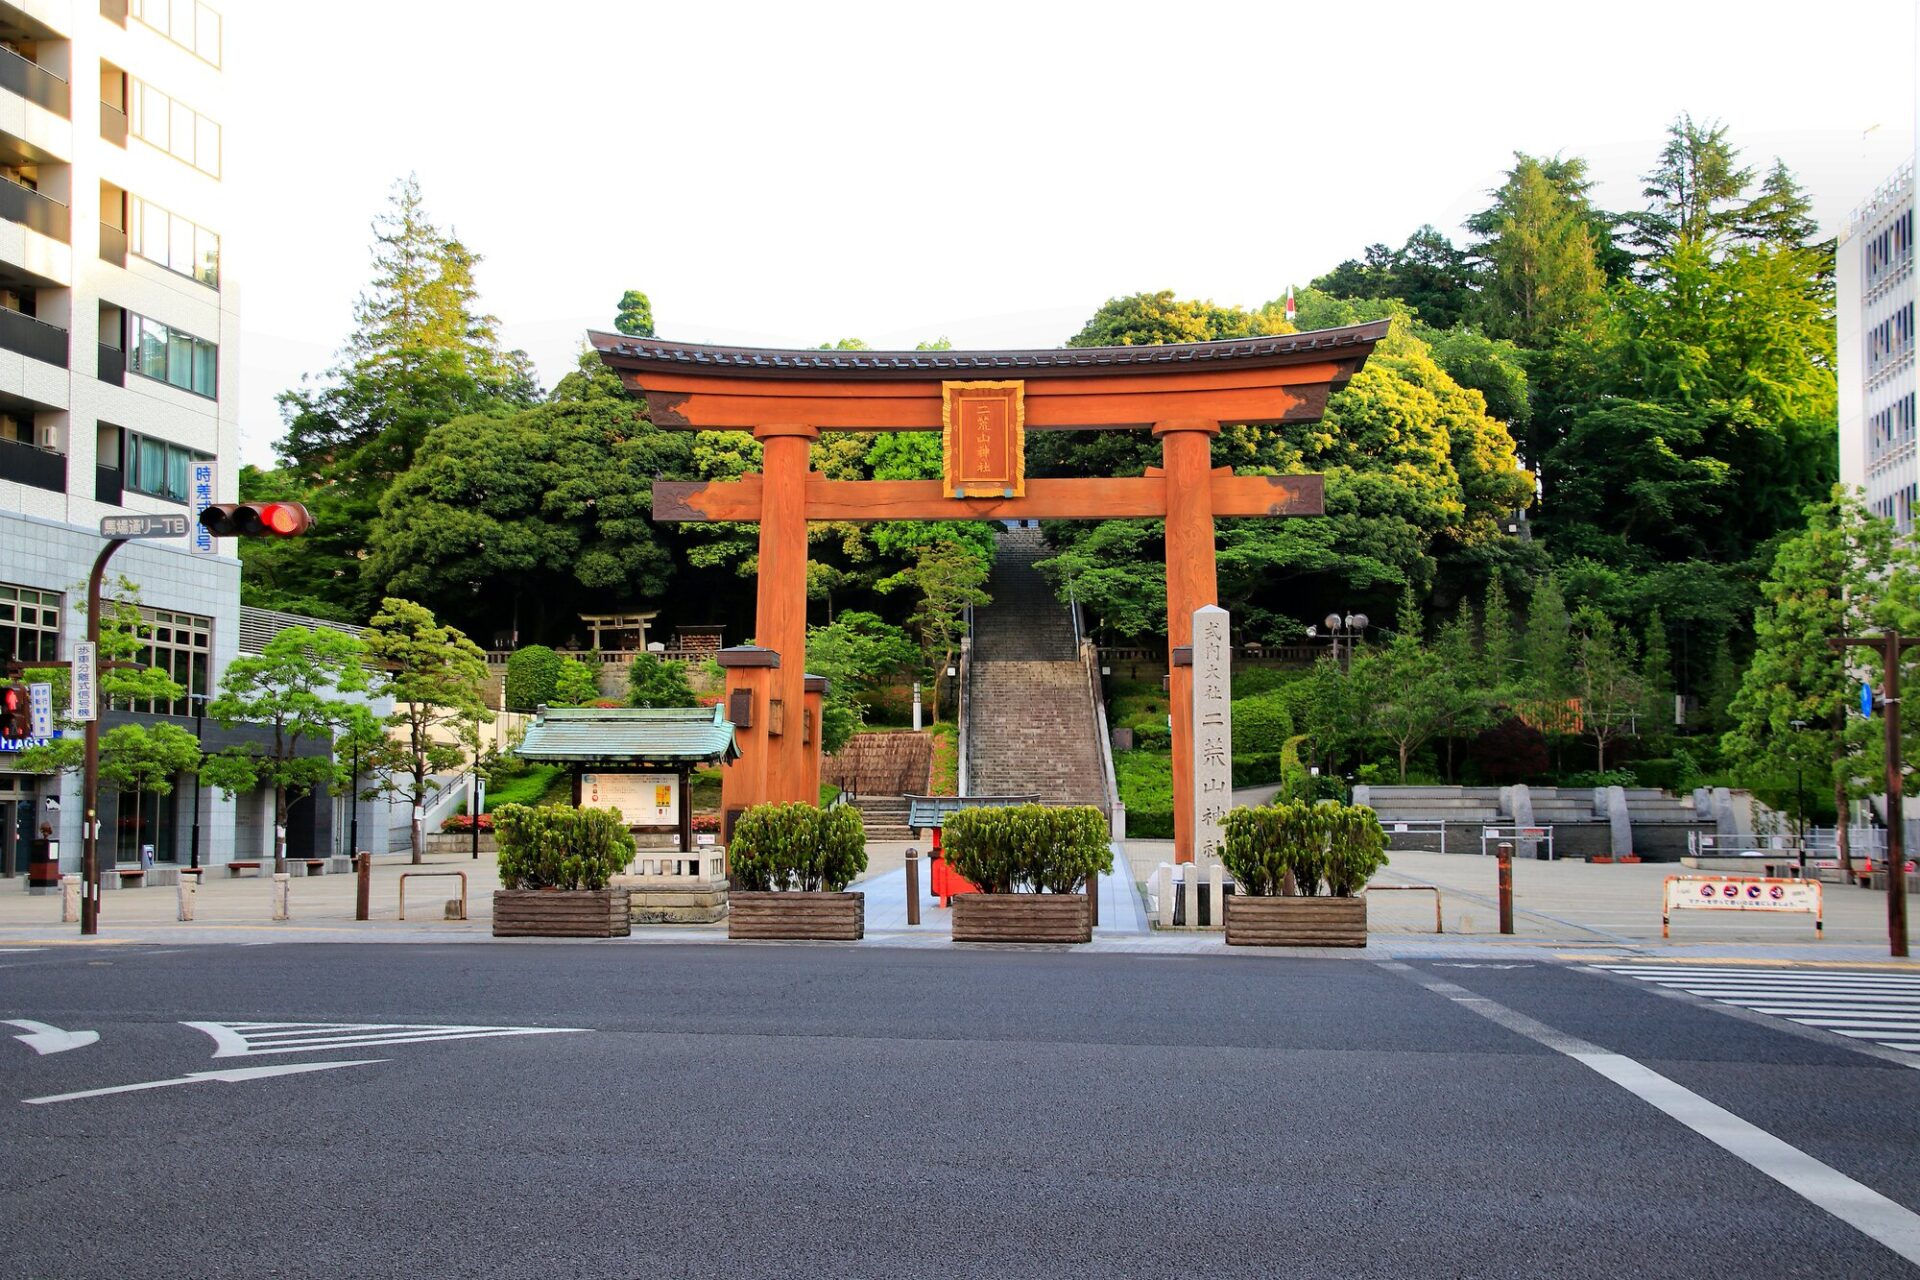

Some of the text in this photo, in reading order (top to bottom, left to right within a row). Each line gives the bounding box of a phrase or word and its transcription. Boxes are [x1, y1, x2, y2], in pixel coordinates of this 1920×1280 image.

[977, 404, 992, 473] 二荒山神社
[103, 518, 185, 535] 馬場通り一丁目
[78, 646, 90, 717] 歩車分離式信号機
